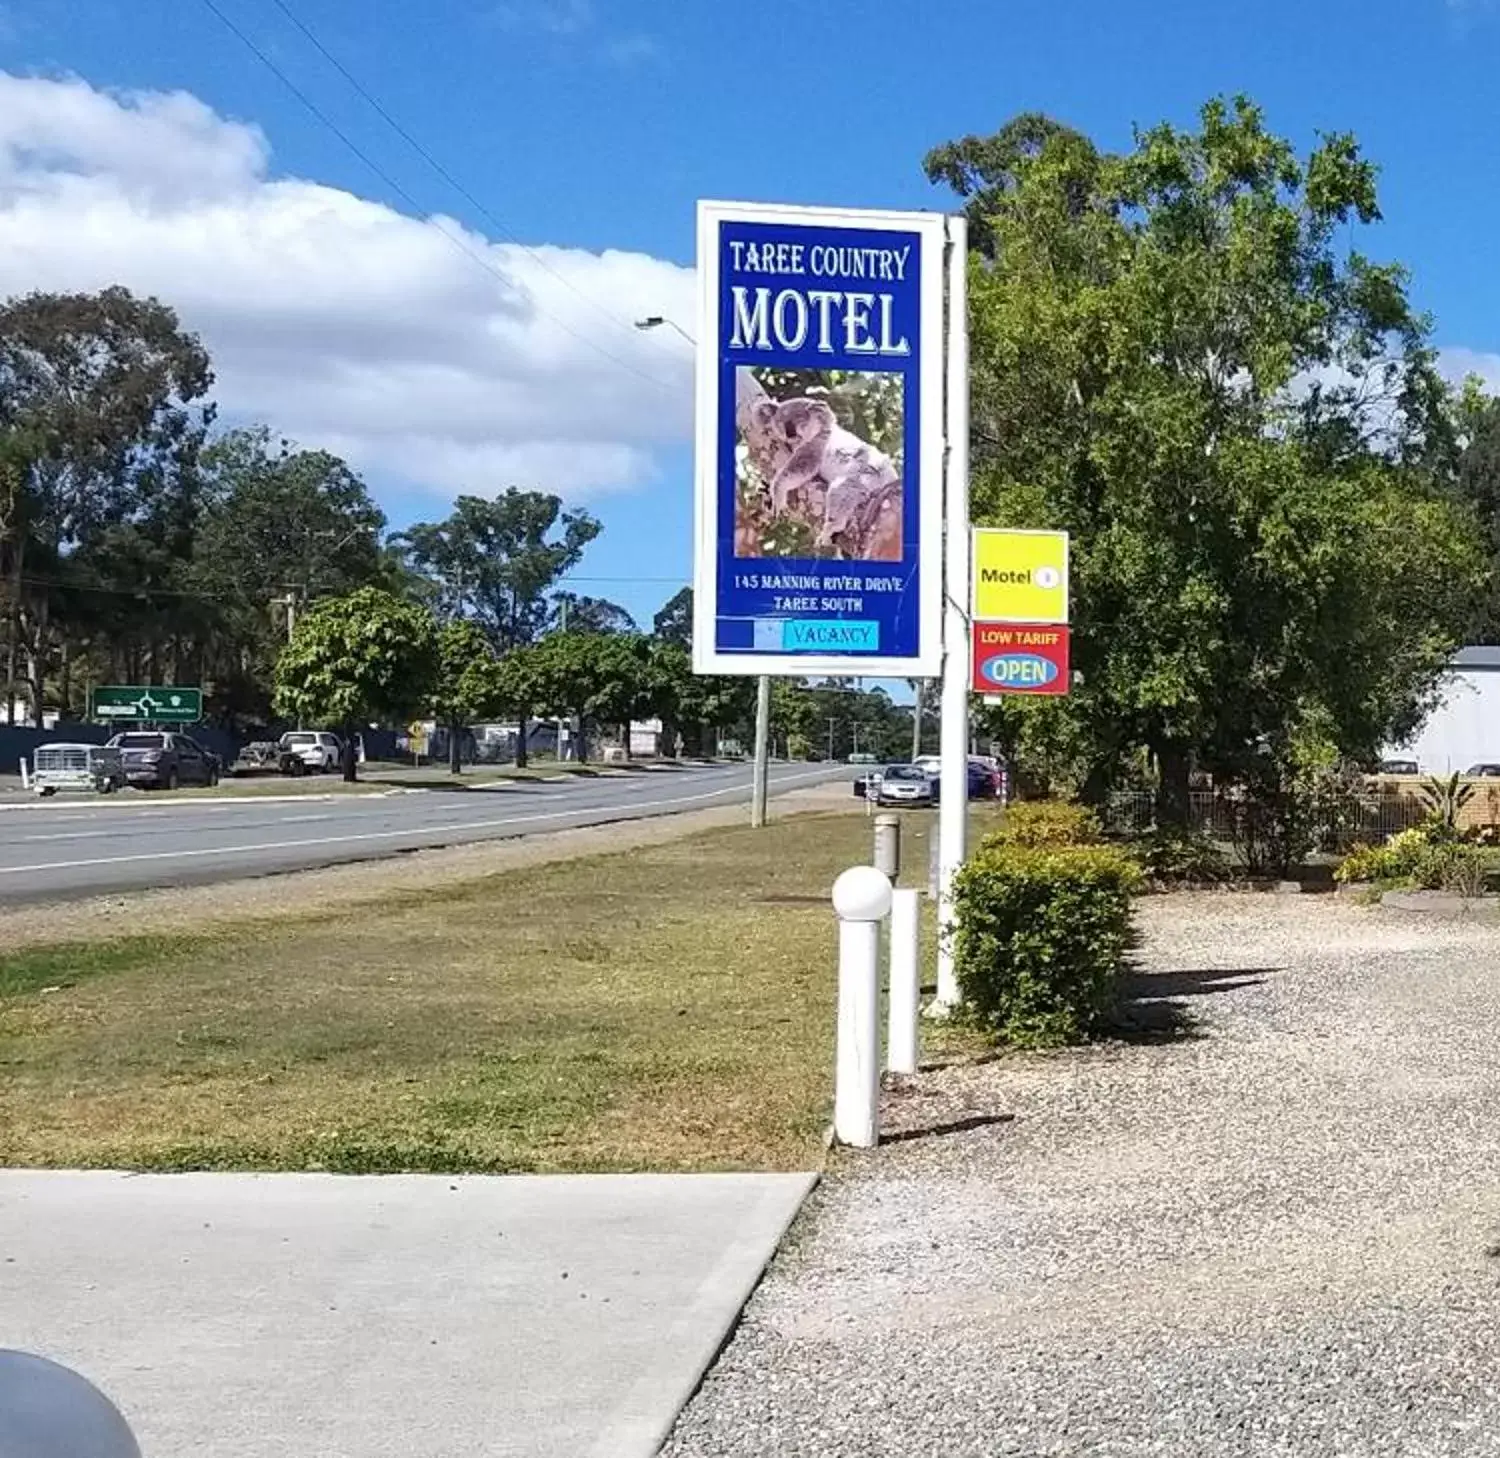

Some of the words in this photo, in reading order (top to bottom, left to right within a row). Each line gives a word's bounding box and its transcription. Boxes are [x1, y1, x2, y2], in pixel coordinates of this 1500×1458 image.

[730, 241, 805, 274] TAREE
[810, 244, 912, 280] COUNTRY
[728, 286, 912, 357] MOTEL
[735, 575, 759, 589] 145
[761, 575, 821, 590] MANNING
[823, 577, 862, 591] RIVER
[865, 577, 904, 592] DRIVE
[981, 567, 1031, 585] Motel
[773, 596, 819, 611] TAREE
[821, 597, 863, 612] SOUTH
[793, 626, 873, 644] VACANCY
[981, 631, 1013, 644] LOW
[1016, 631, 1061, 646] TARIFF
[991, 660, 1048, 682] OPEN
